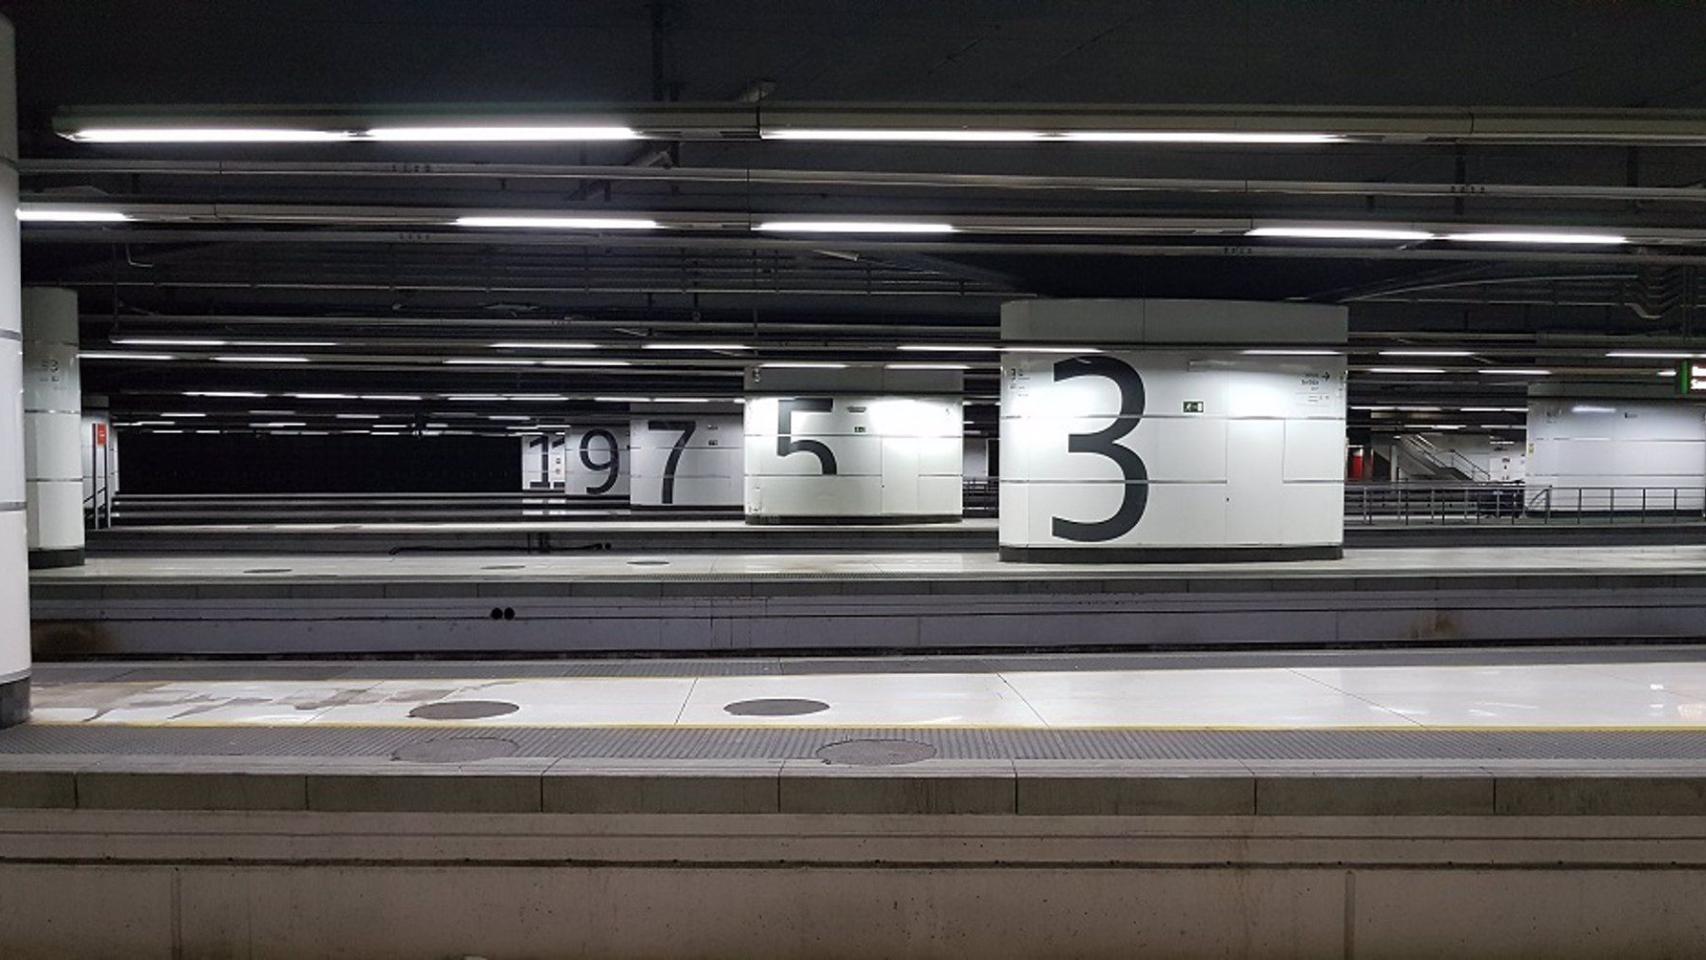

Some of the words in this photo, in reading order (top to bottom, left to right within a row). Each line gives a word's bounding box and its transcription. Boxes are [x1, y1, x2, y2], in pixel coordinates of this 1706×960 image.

[580, 429, 619, 494] 9
[648, 420, 697, 504] 7
[777, 398, 838, 475] 5
[1052, 356, 1149, 542] 3
